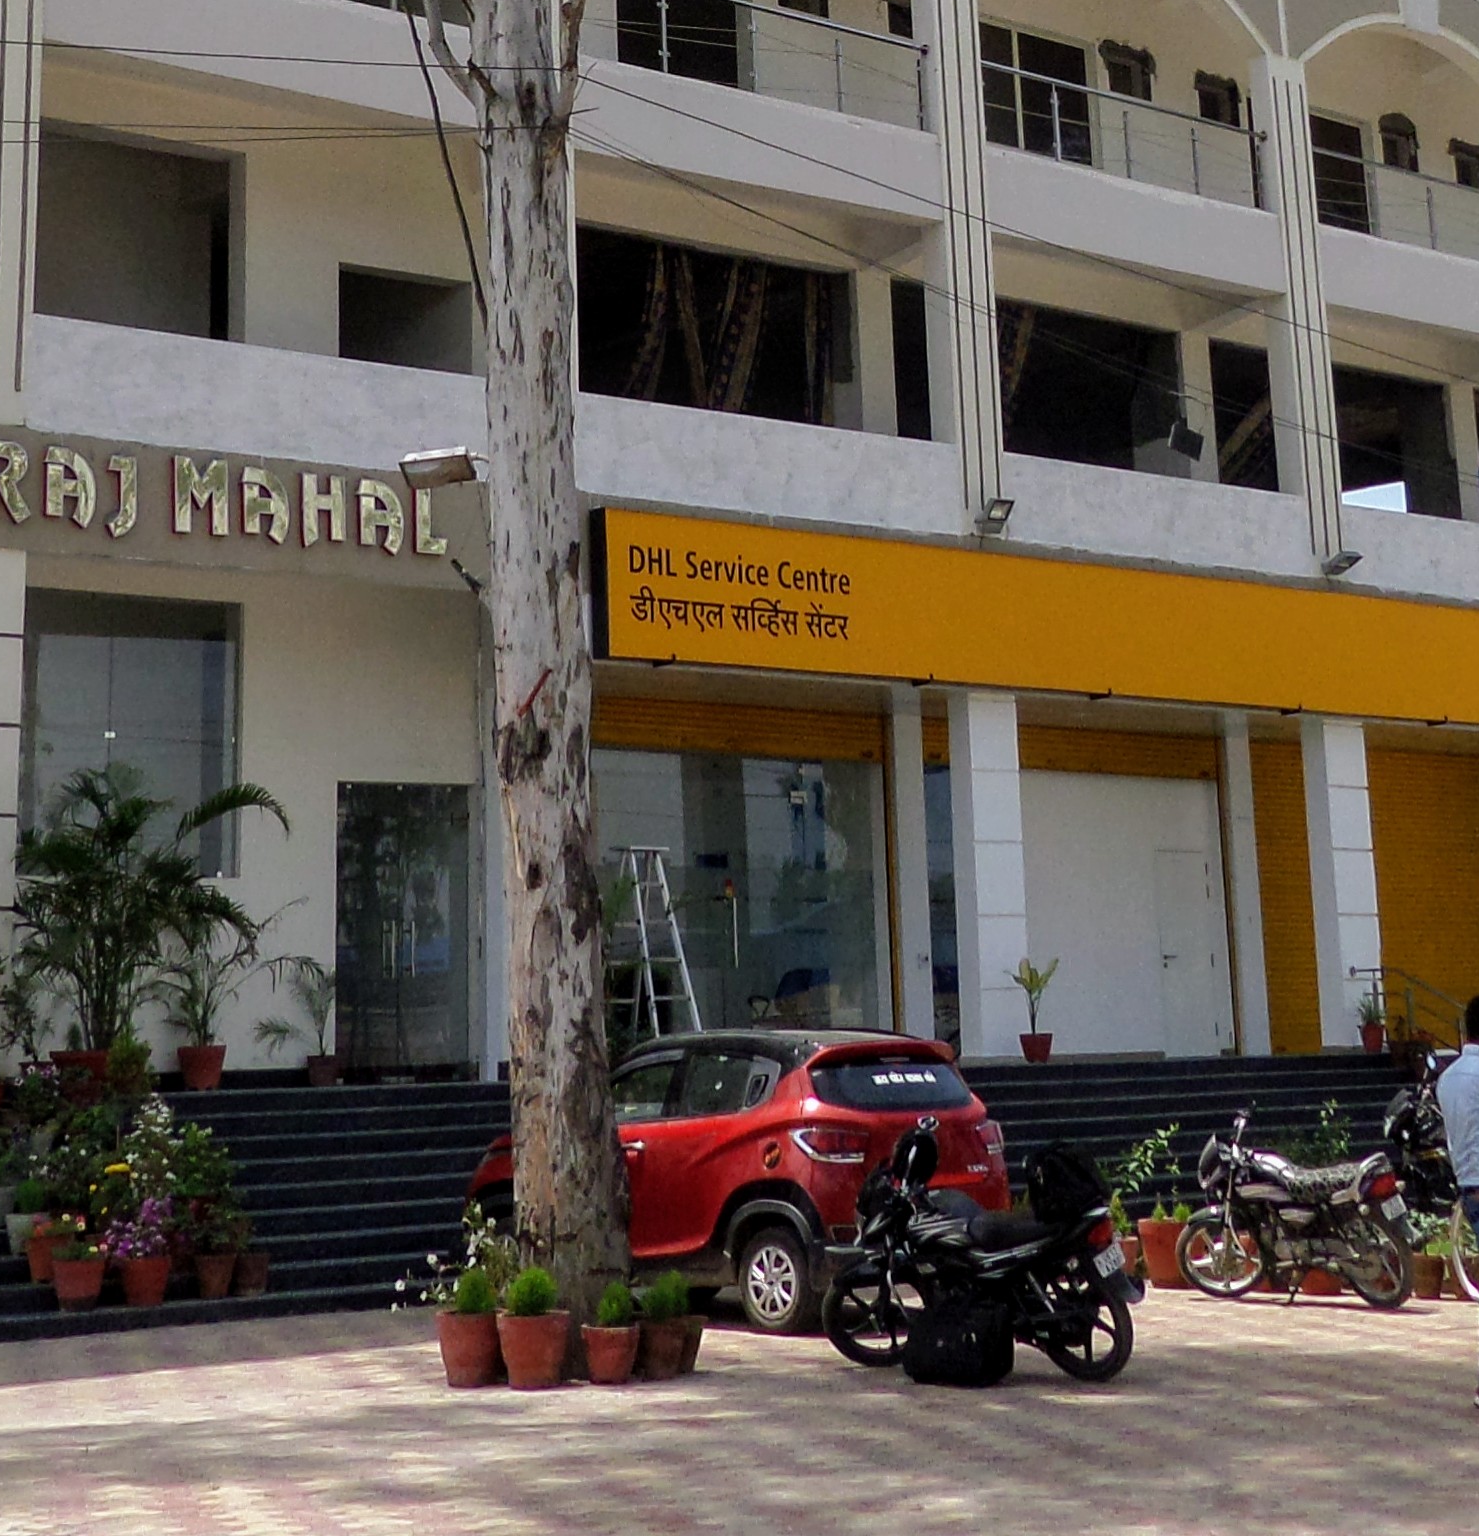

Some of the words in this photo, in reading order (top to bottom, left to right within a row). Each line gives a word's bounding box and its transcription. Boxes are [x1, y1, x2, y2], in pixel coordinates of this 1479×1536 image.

[172, 453, 448, 556] MAHAL
[628, 544, 677, 577] DHL
[686, 551, 769, 586] Service
[777, 561, 851, 595] Centre
[630, 586, 725, 632] डीएचएल
[804, 602, 849, 640] सेंटर
